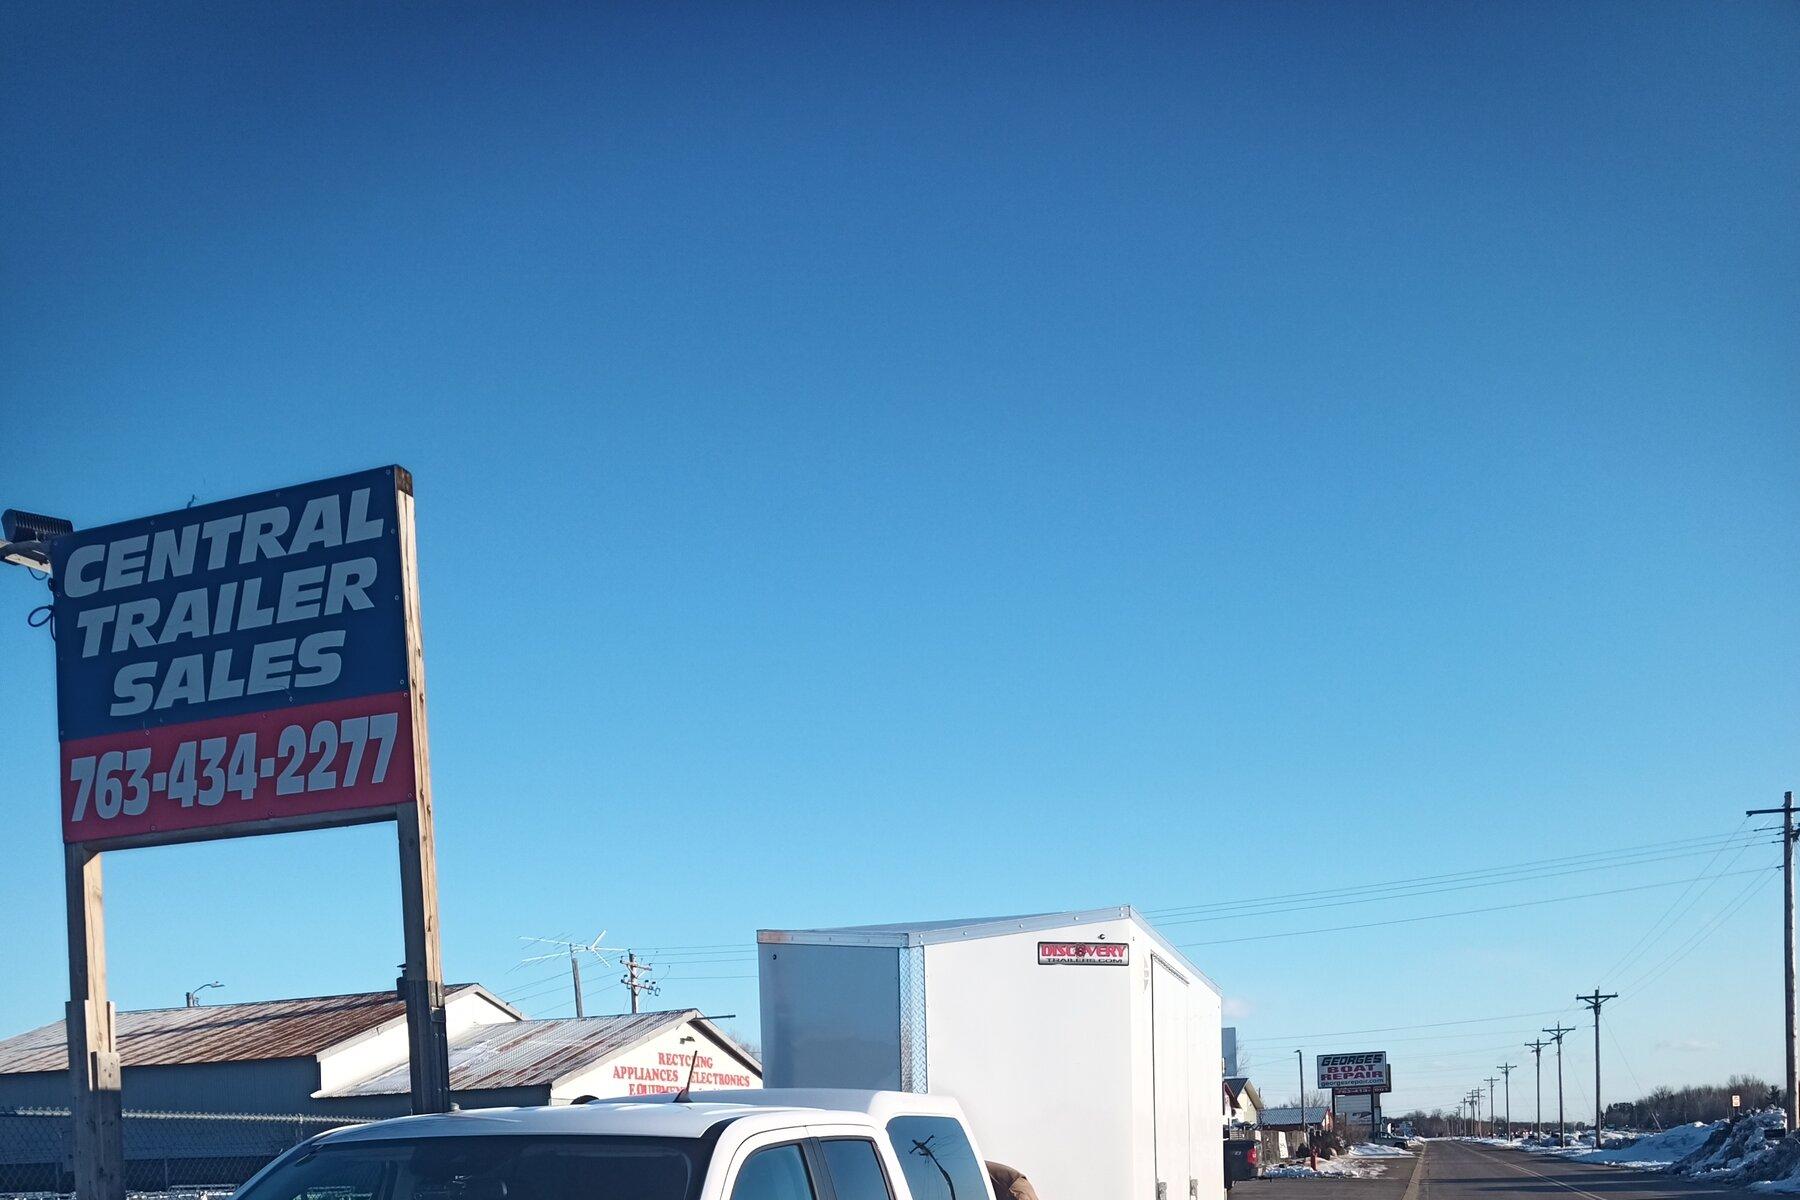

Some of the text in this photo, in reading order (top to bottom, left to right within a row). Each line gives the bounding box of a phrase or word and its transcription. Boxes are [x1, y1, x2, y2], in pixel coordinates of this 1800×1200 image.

[63, 487, 385, 599] CENTRAL
[76, 556, 379, 659] TRAILER
[109, 628, 347, 717] SALES
[70, 712, 399, 823] 763-434-2277
[1042, 944, 1126, 957] DISCOVERY
[1322, 1054, 1383, 1066] GEORGES
[613, 1065, 679, 1082] APPLIANCES
[1321, 1071, 1383, 1081] REPAIR
[1328, 1065, 1375, 1073] BOAT
